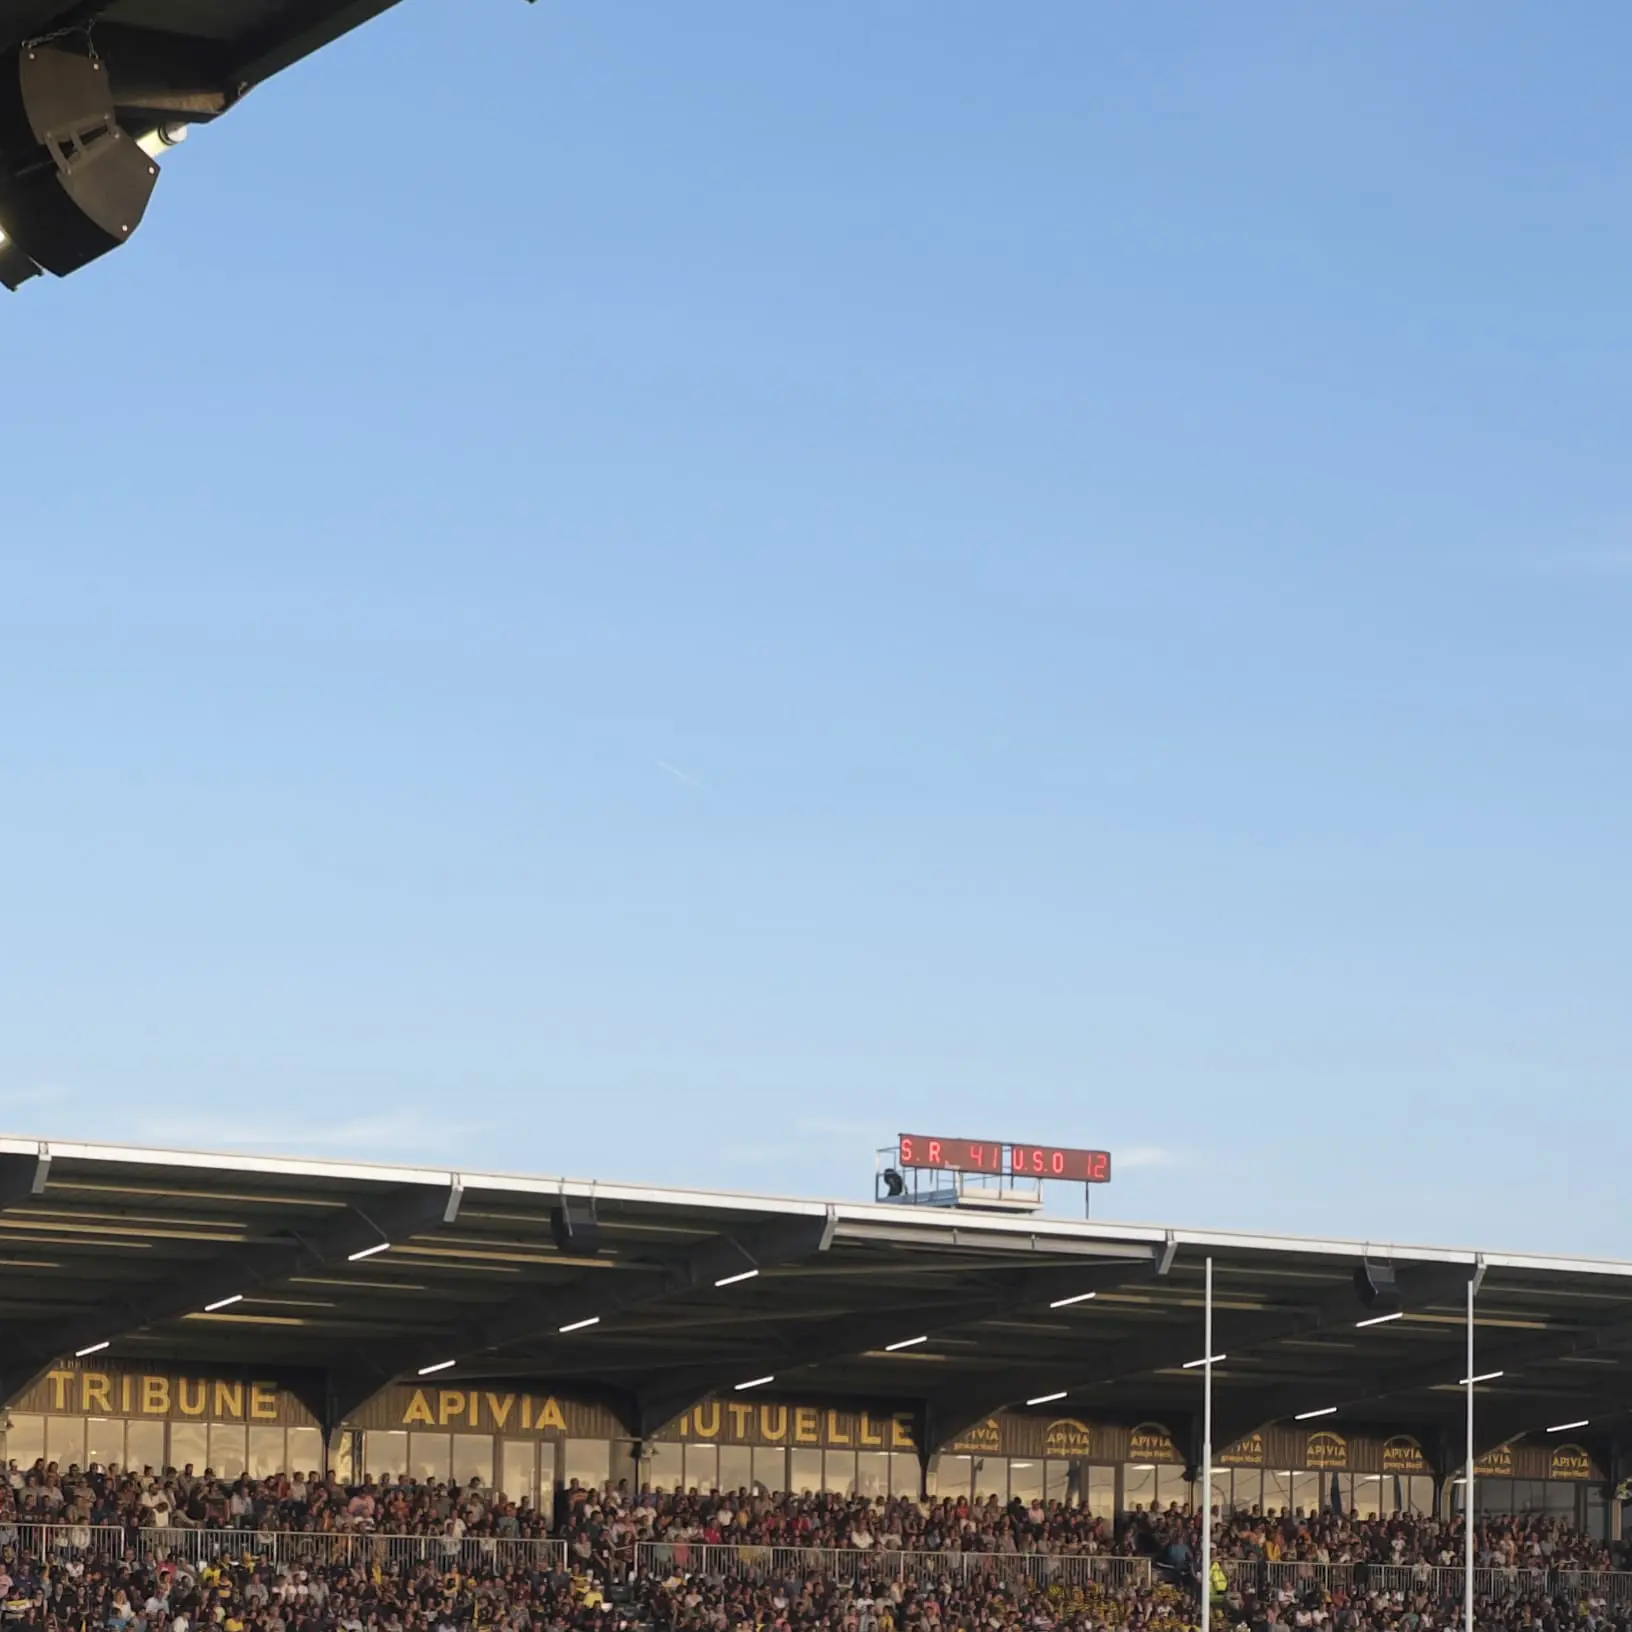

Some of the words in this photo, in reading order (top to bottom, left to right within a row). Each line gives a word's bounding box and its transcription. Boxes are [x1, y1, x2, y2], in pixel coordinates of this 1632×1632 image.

[970, 1145, 997, 1168] 41
[1087, 1153, 1107, 1178] 12
[46, 1370, 277, 1418] TRIBUNE
[402, 1388, 567, 1430] APIVIA
[680, 1401, 914, 1446] UTUELLE
[1047, 1432, 1089, 1445] APIVIA
[1131, 1435, 1171, 1447] APIVIA
[1307, 1444, 1347, 1457] APIVIA
[1384, 1447, 1422, 1459] APIVIA
[1552, 1455, 1589, 1468] APIVIA
